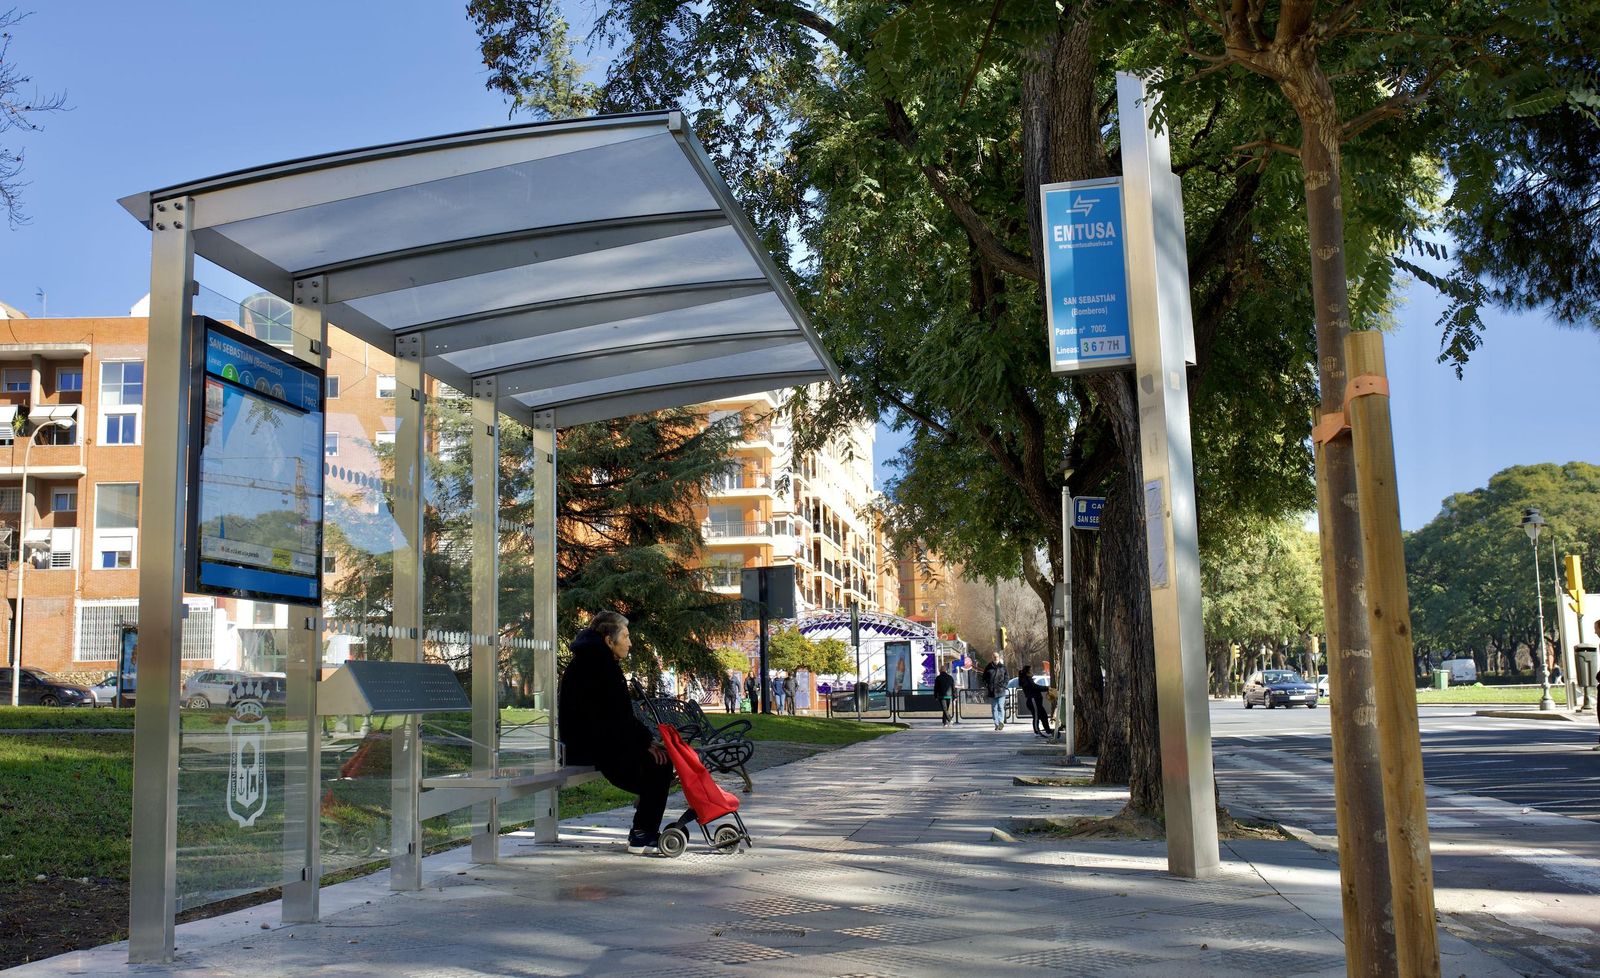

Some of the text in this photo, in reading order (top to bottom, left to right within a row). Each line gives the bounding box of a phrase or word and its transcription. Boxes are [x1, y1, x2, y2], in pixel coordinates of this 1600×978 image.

[1054, 222, 1115, 242] EMTUSA
[1064, 294, 1115, 305] SAN SEBASTIÁN
[1072, 307, 1107, 317] (Bomberos)
[1056, 327, 1077, 335] Parada
[1091, 325, 1106, 333] 7002
[209, 338, 221, 350] SAN
[1083, 342, 1089, 352] 3
[1092, 342, 1097, 352] 6
